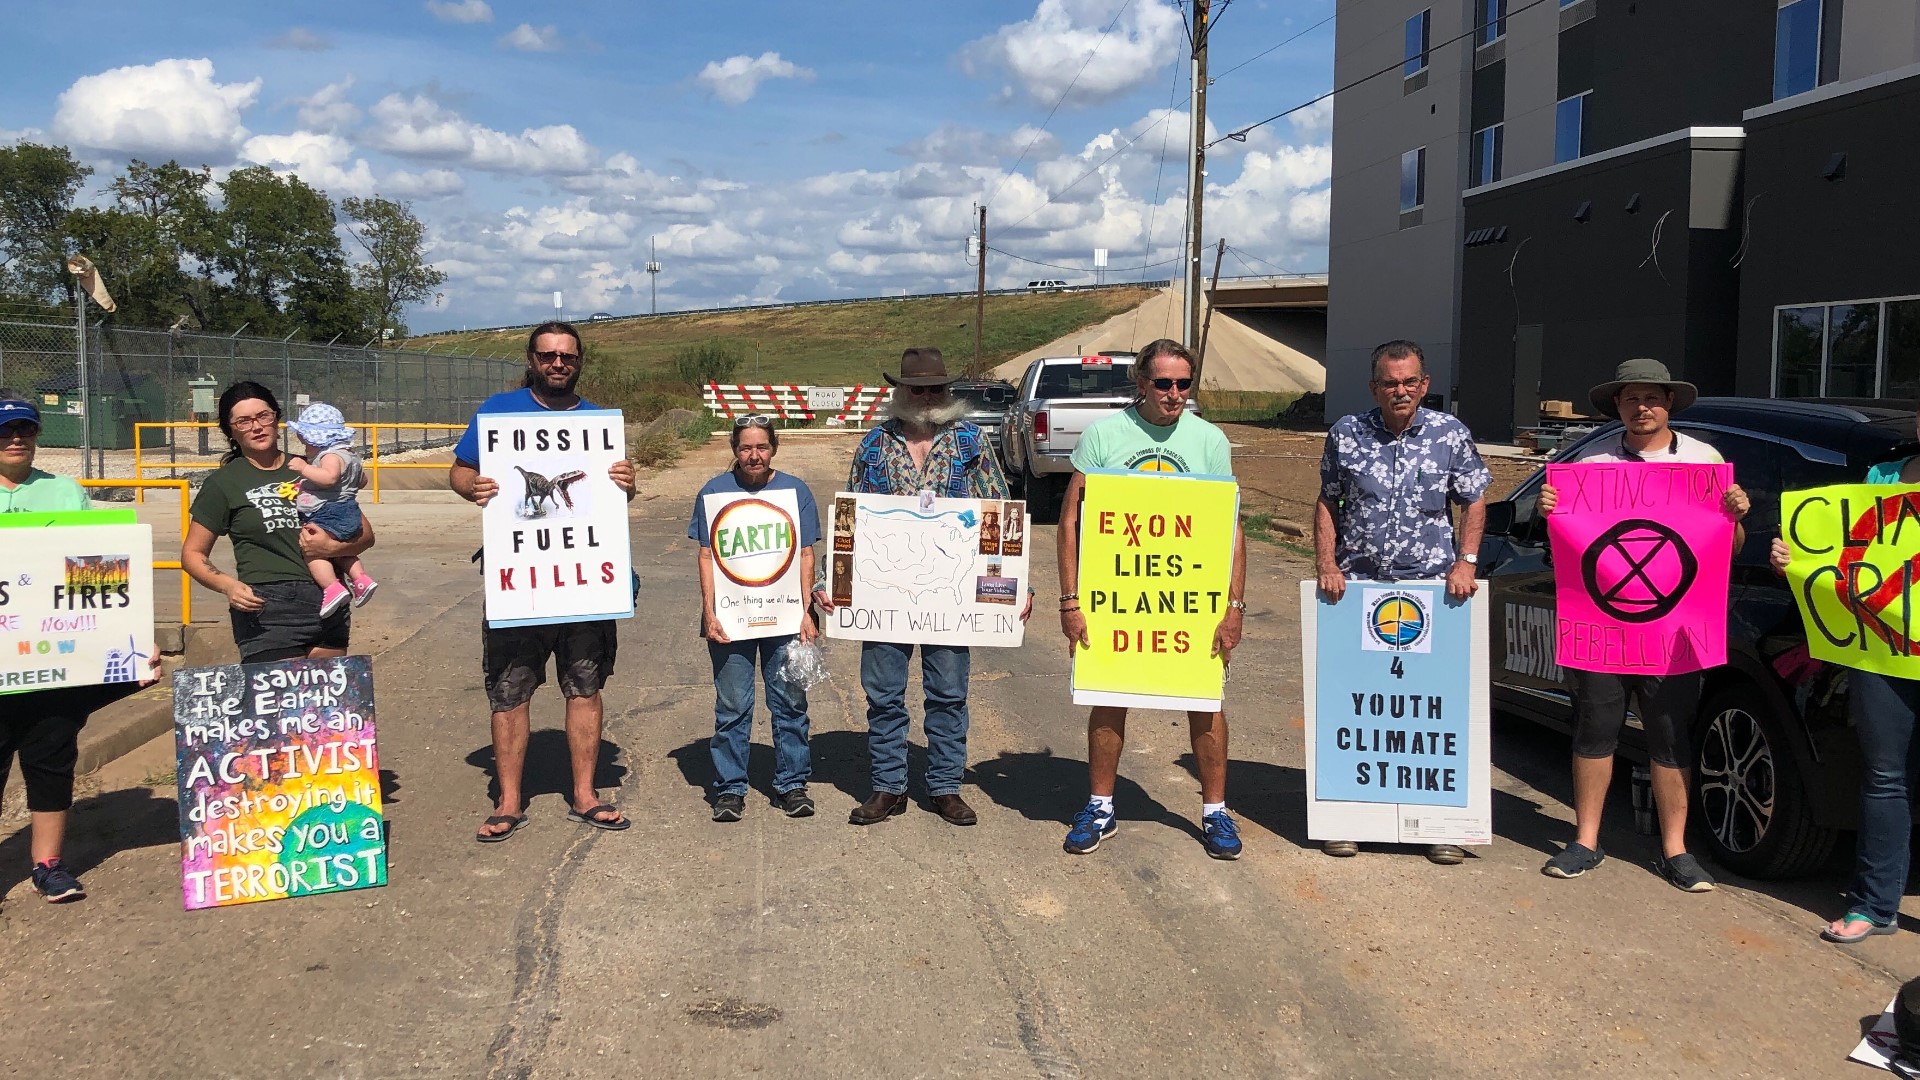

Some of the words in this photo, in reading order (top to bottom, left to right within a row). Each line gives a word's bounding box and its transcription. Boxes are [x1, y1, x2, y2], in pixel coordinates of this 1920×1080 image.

[487, 427, 614, 453] FOSSIL
[1549, 465, 1730, 516] EXTINCTION
[512, 525, 600, 554] FUEL
[717, 521, 791, 559] EARTH
[18, 573, 32, 587] &
[53, 583, 130, 611] FIRES
[499, 561, 615, 592] KILLS
[720, 595, 740, 609] One
[743, 594, 763, 609] thing
[776, 594, 785, 604] all
[1090, 590, 1222, 615] PLANET
[747, 615, 778, 623] common
[907, 611, 951, 632] WALL
[956, 613, 985, 633] ME
[993, 613, 1014, 633] IN
[18, 639, 76, 656] NOW
[1113, 629, 1190, 654] DIES
[1504, 602, 1564, 684] ELECTRI
[1557, 618, 1709, 667] REBELLION
[192, 671, 227, 697] If
[252, 665, 348, 696] saving
[1390, 655, 1404, 679] 4
[190, 695, 243, 719] the
[255, 685, 338, 716] Earth
[1351, 692, 1442, 720] YOUTH
[185, 716, 270, 747] makes
[281, 712, 320, 735] me
[328, 709, 363, 732] an
[1336, 727, 1457, 756] CLIMATE
[185, 738, 376, 789] ACTIVIST
[1356, 761, 1456, 792] STRIKE
[188, 782, 348, 824] destroying
[355, 780, 376, 805] it
[188, 823, 287, 862] makes
[292, 821, 349, 853] you
[360, 816, 380, 842] a
[185, 848, 384, 904] TERRORIST
